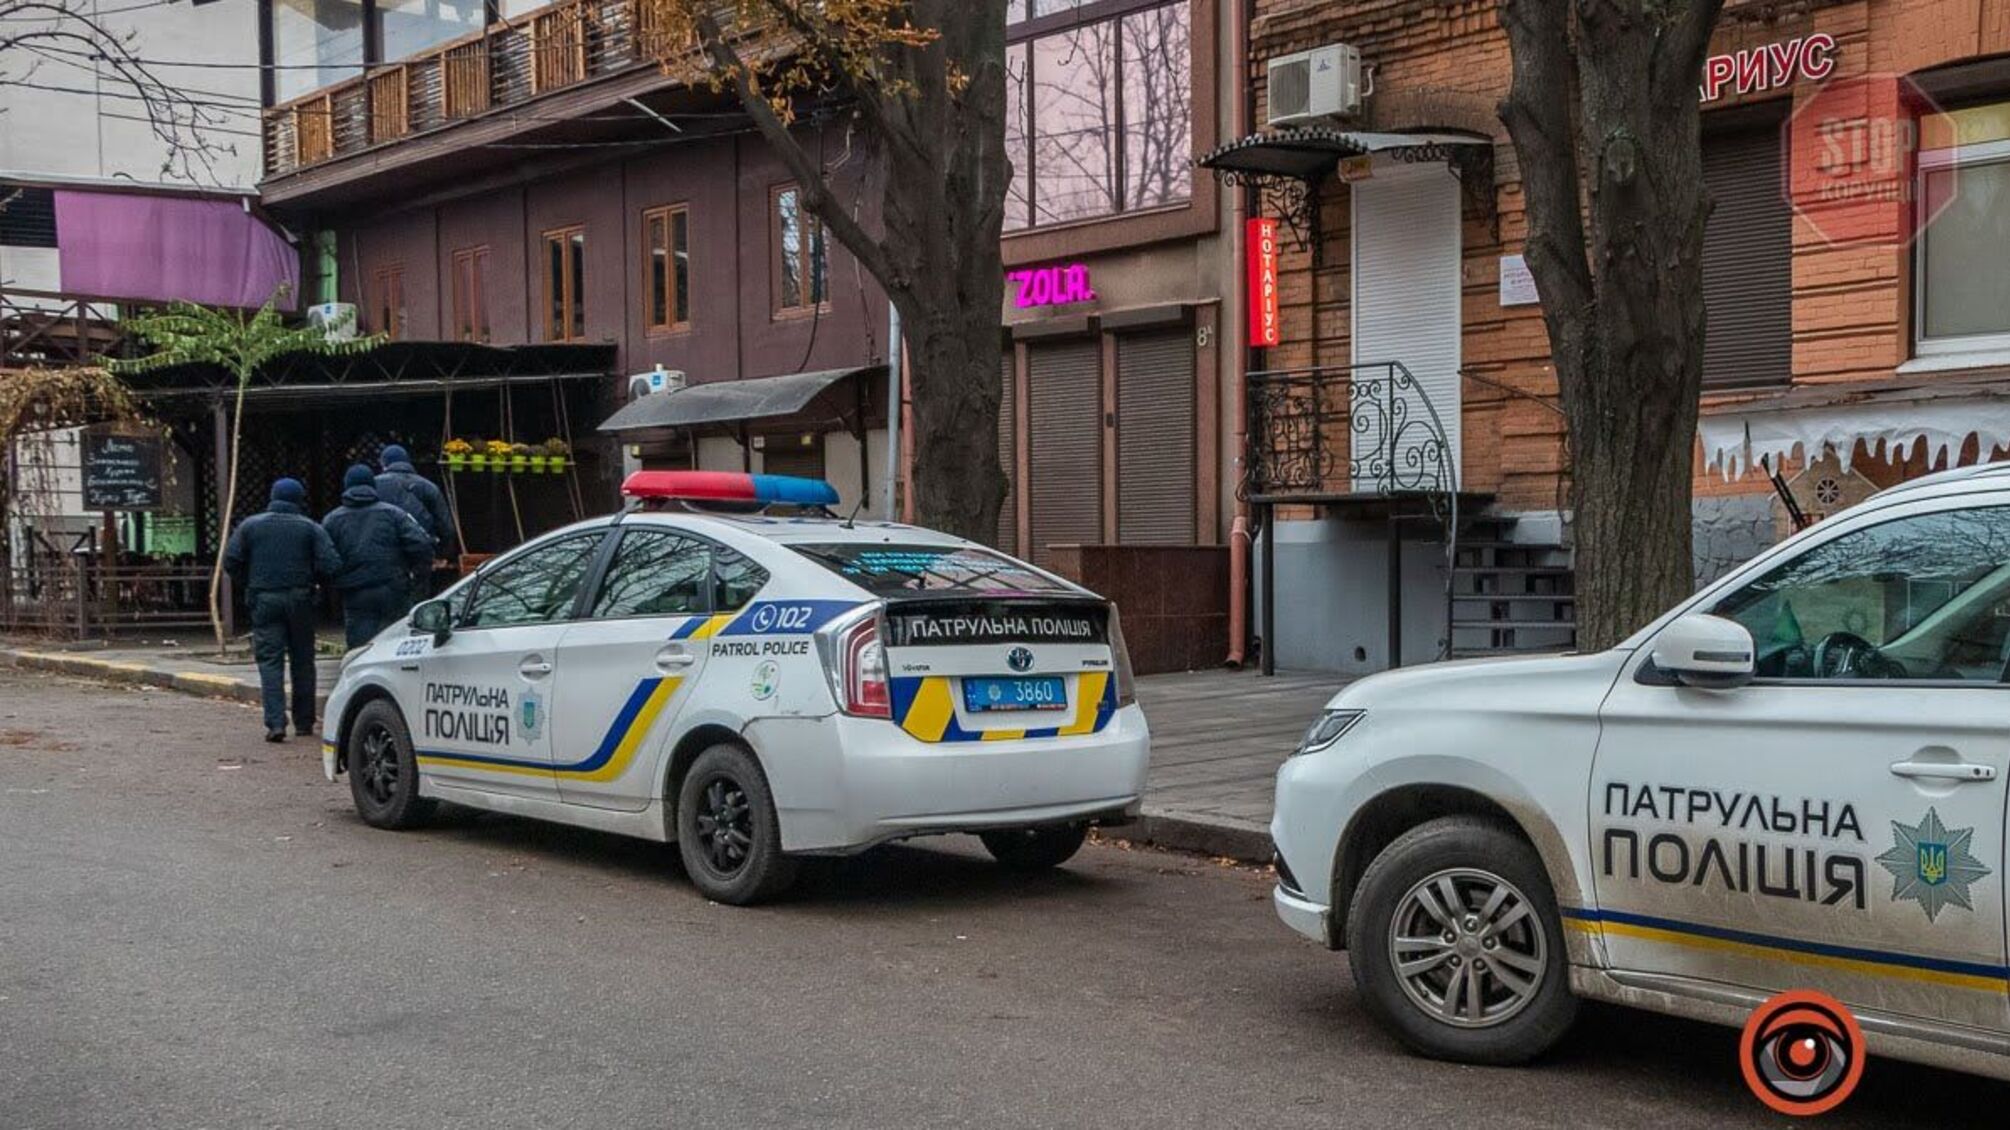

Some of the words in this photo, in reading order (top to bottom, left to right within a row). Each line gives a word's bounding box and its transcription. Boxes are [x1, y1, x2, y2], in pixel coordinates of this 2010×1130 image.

[1699, 33, 1834, 102] РИУС
[1261, 224, 1275, 342] НОТАРІУС
[776, 607, 812, 628] 102
[911, 619, 1029, 639] ПАТРУЛЬНА
[1032, 618, 1092, 637] ПОЛІЦІЯ
[711, 642, 760, 657] PATROL
[763, 641, 809, 656] POLICE
[1014, 681, 1053, 702] 3860
[1604, 782, 1864, 842] ПАТРУЛЬНА
[1603, 827, 1866, 910] ПОЛІЦІЯ
